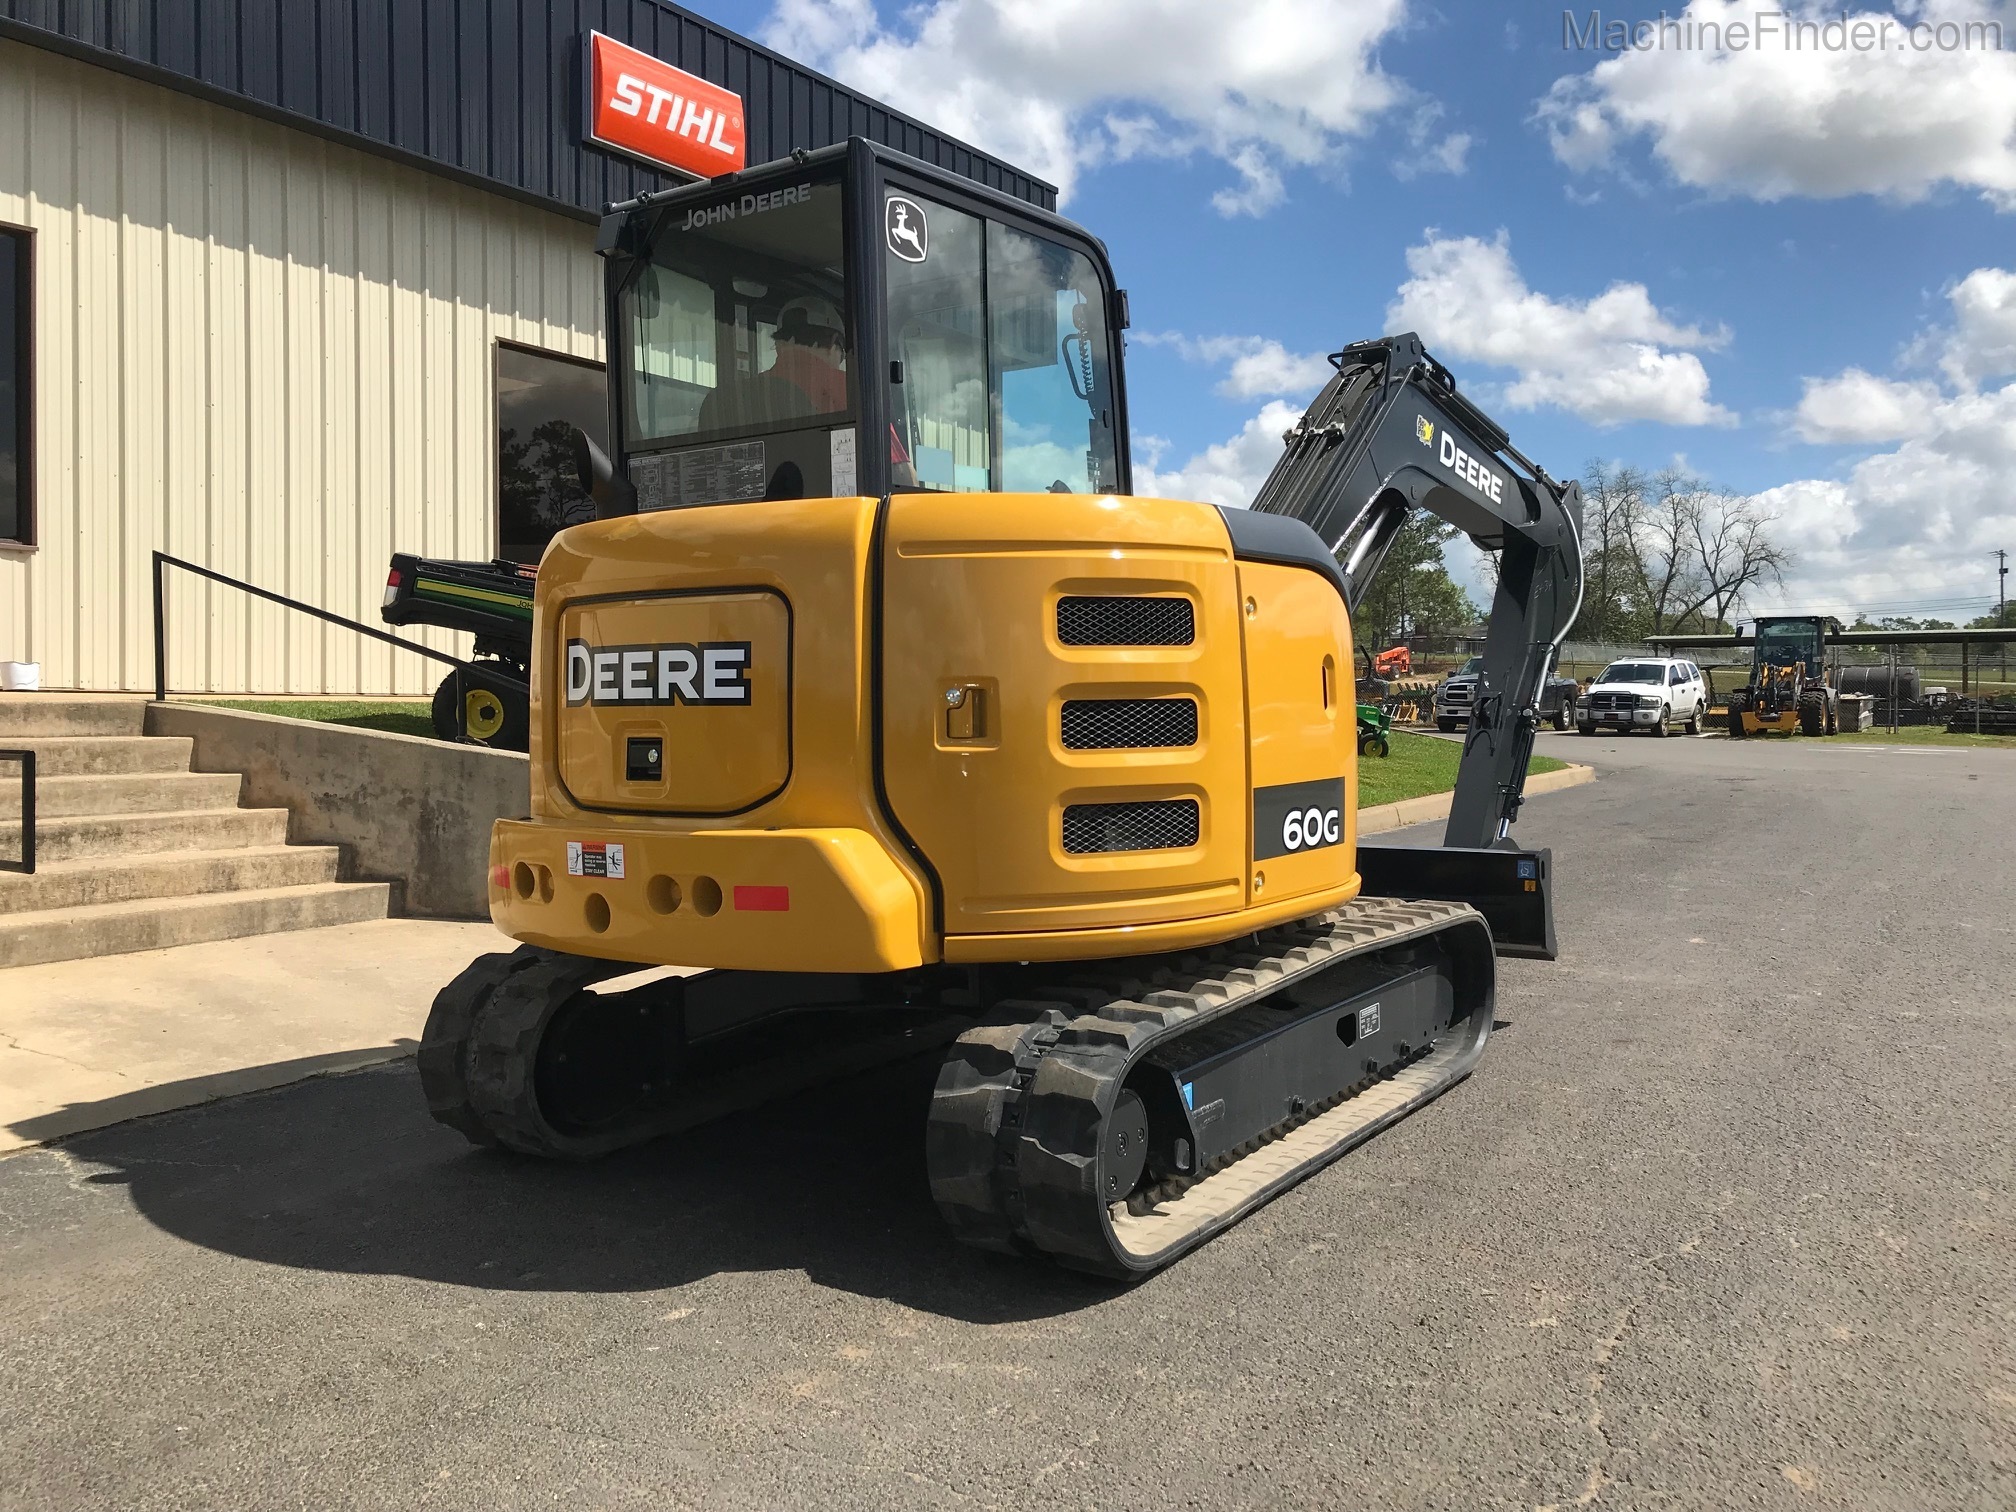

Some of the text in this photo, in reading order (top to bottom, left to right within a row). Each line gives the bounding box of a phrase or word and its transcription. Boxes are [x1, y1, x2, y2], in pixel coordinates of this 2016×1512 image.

[609, 73, 736, 155] STIHL
[681, 183, 811, 231] JOHN DEERE
[1440, 430, 1502, 505] DEERE
[568, 644, 745, 701] DEERE
[1283, 808, 1339, 850] 60G
